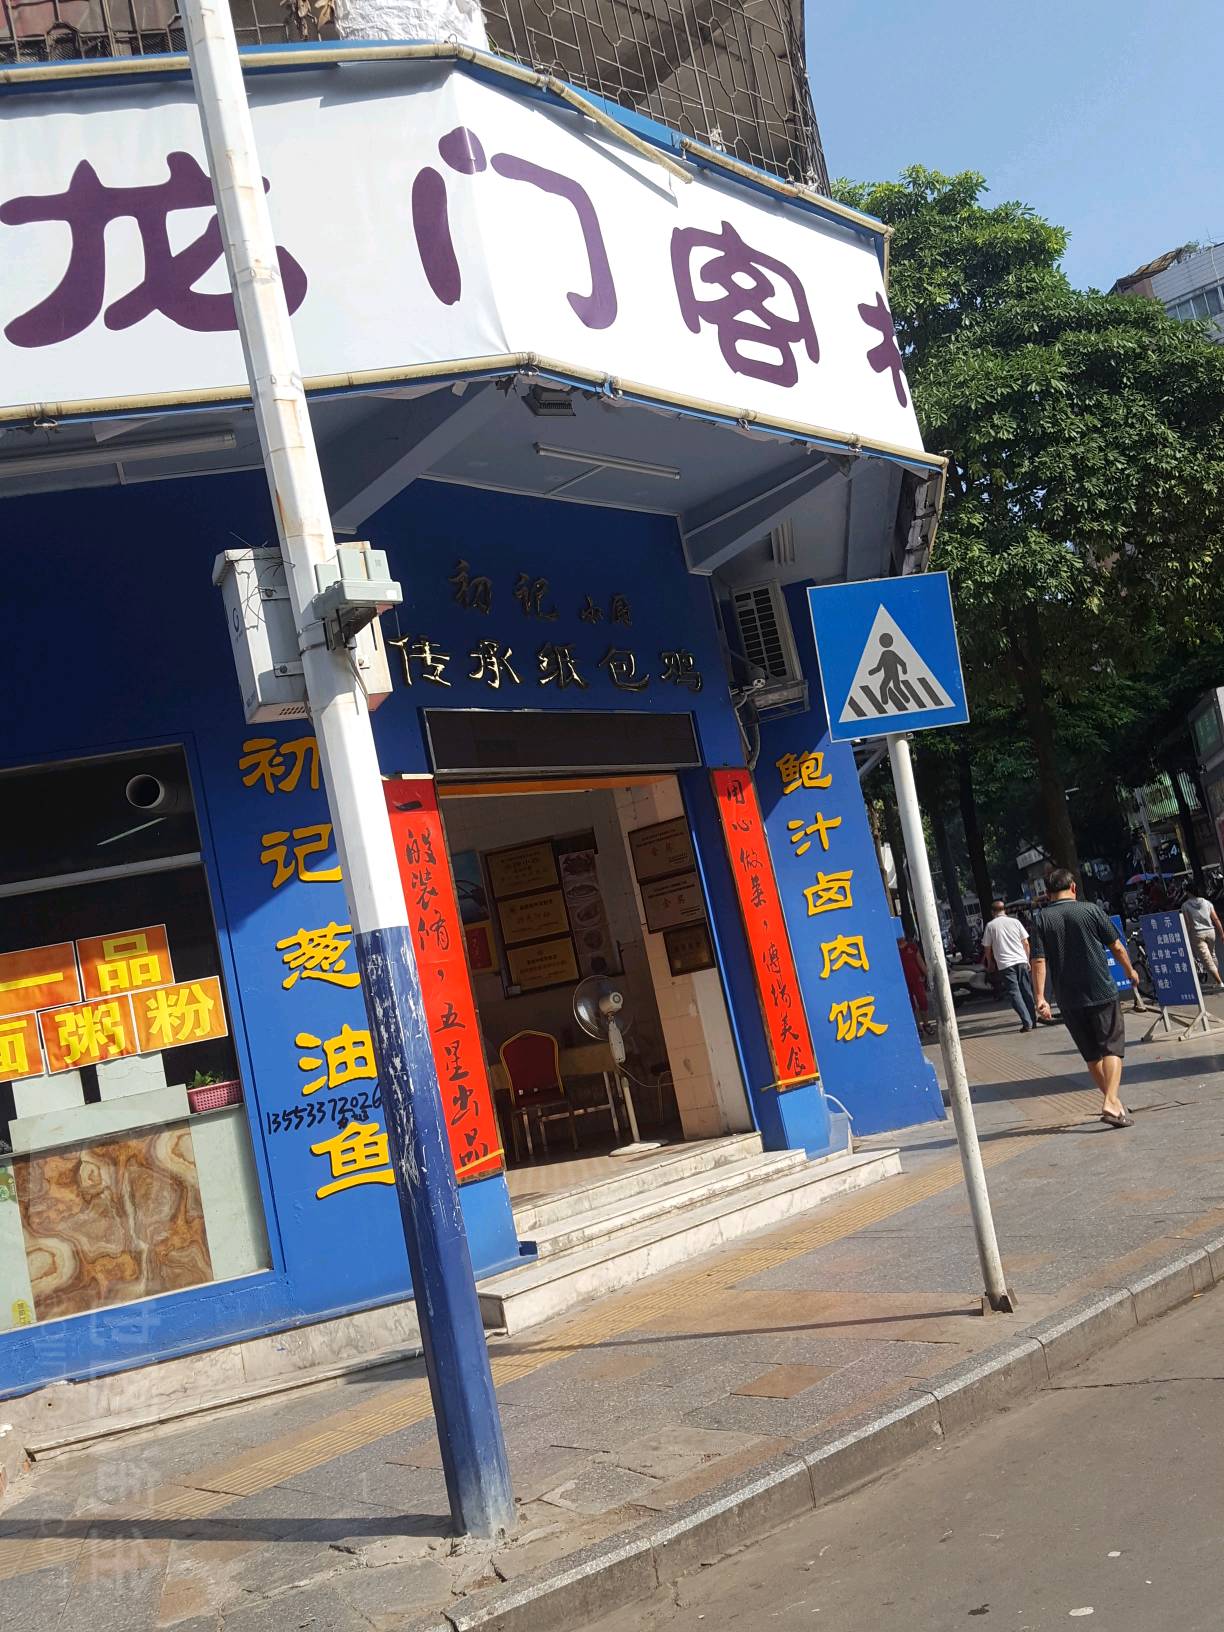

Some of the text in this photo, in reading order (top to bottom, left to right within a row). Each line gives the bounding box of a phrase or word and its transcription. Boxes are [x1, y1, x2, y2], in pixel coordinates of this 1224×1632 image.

[388, 635, 702, 692] 传承纸包鸡
[775, 752, 888, 1042] 鲍汁卤肉饭
